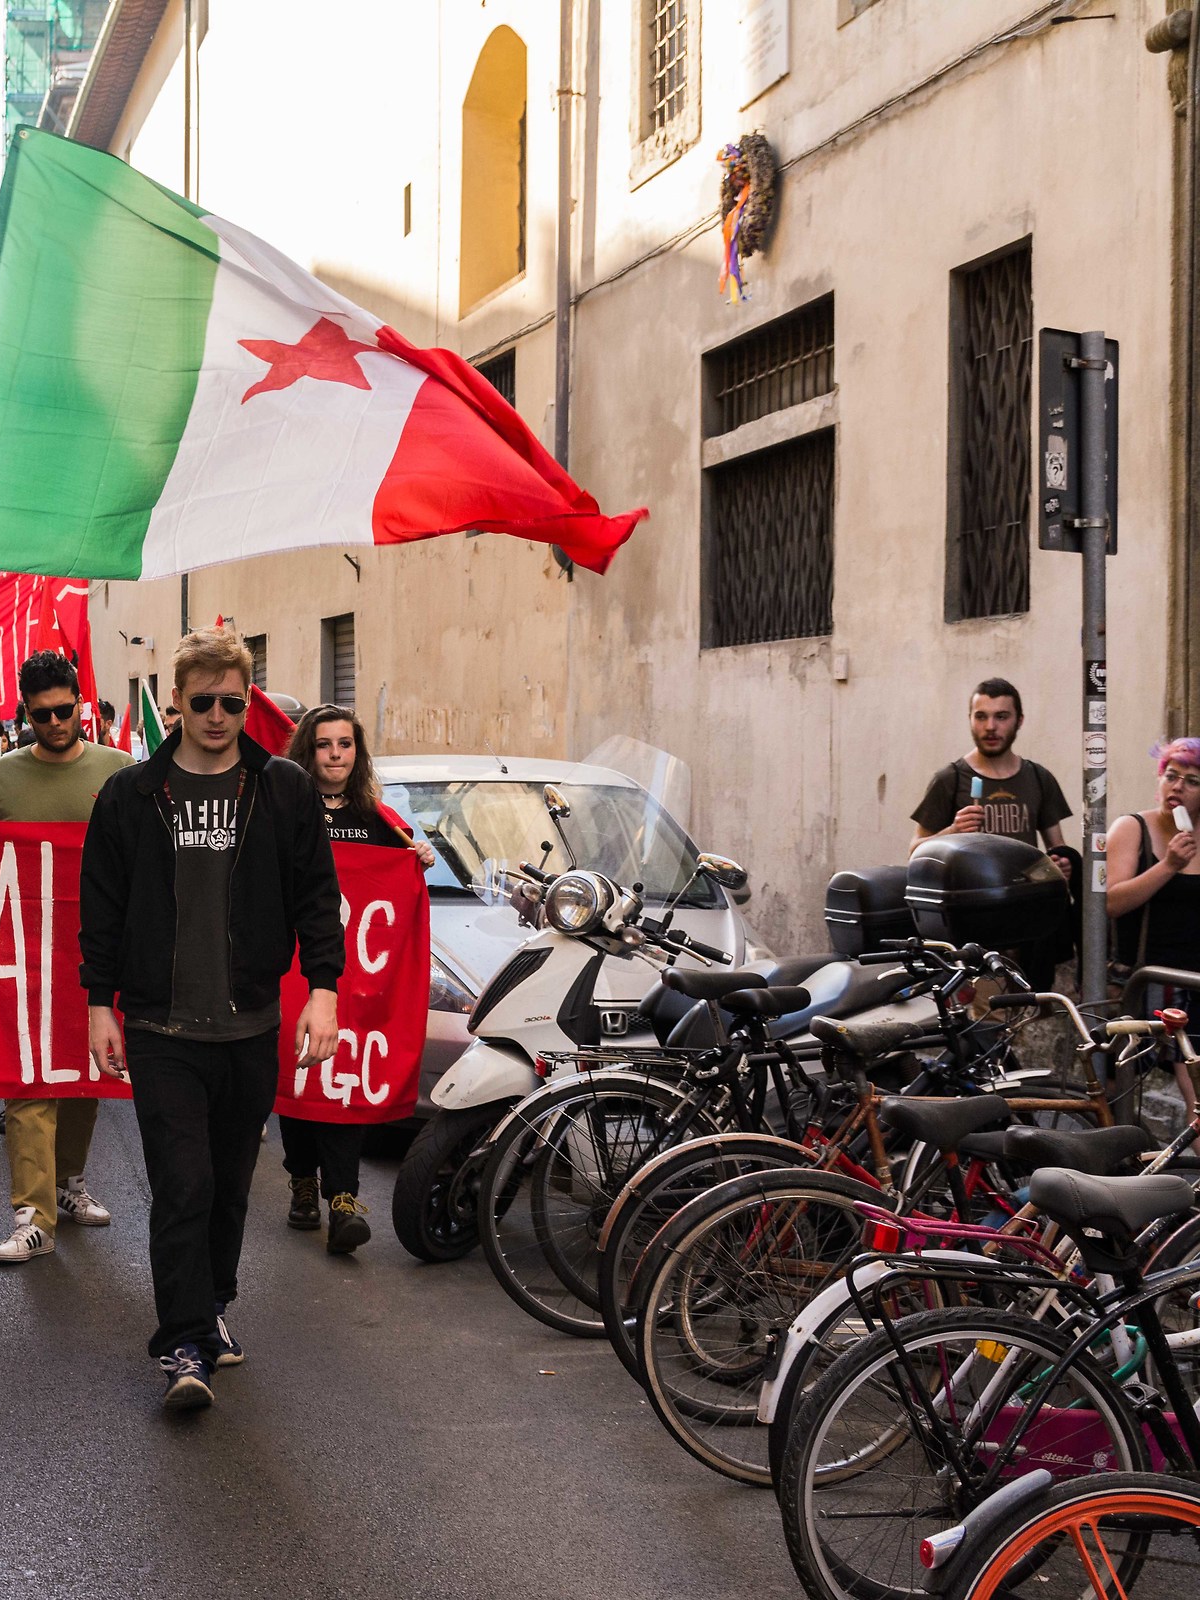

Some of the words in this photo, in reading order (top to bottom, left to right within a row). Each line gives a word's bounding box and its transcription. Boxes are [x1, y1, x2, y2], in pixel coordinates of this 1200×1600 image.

[981, 803, 1030, 833] OHIBA
[179, 830, 207, 846] 1917
[326, 828, 369, 839] ISTERS
